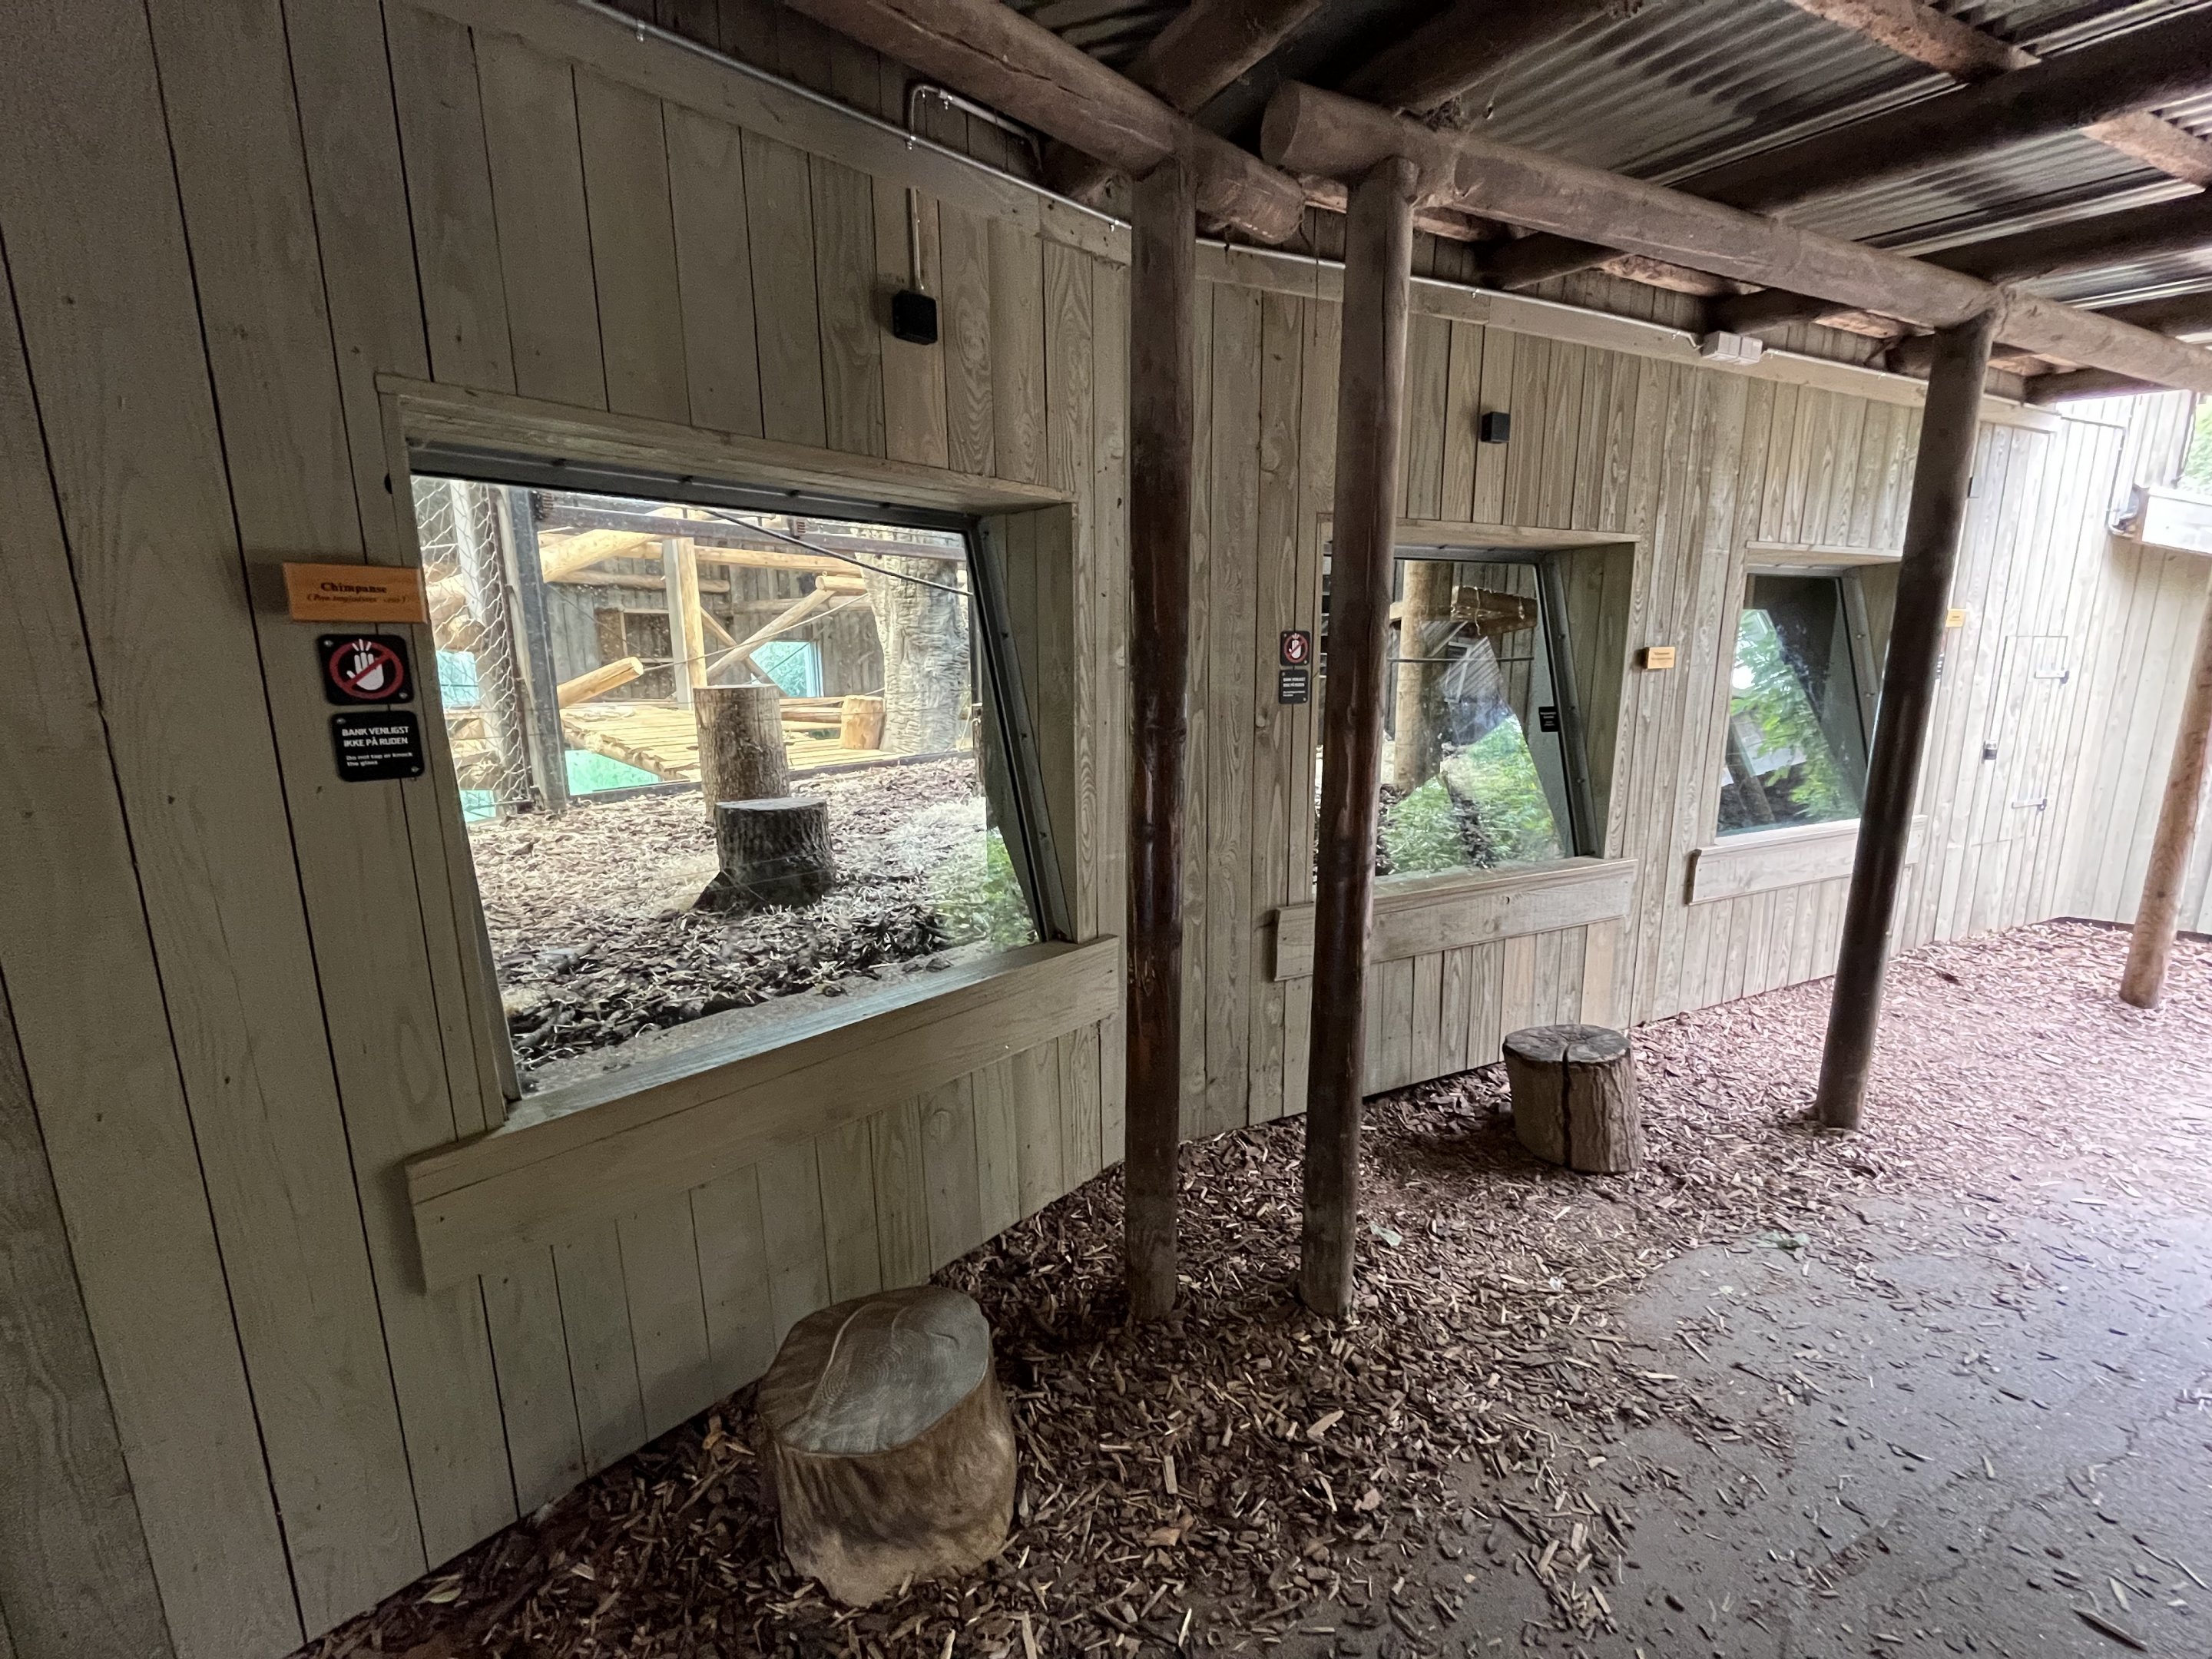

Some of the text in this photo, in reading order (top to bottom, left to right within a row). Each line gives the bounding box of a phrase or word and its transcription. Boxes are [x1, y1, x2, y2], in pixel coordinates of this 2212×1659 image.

[321, 582, 387, 594] Chimpanse
[369, 727, 409, 735] VENLIGST
[366, 736, 379, 746] PÅ
